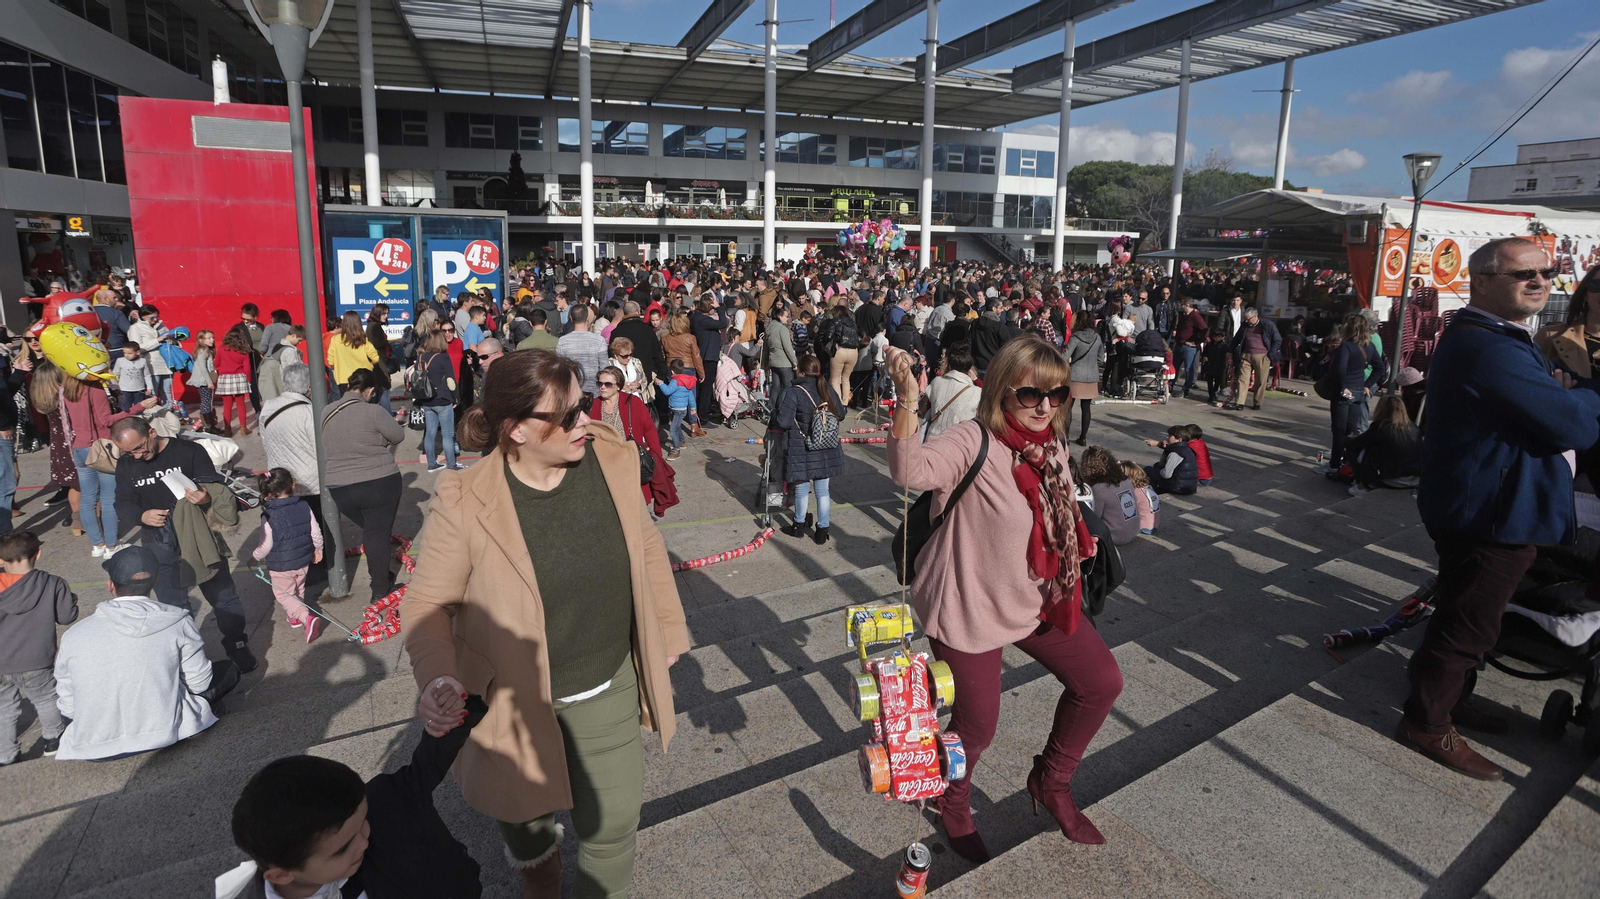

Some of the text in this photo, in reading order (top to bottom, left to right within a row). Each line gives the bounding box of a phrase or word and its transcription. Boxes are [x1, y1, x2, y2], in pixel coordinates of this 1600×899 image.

[376, 242, 392, 266] 4
[392, 260, 401, 268] 24
[467, 244, 481, 266] 4
[337, 250, 380, 304] P
[432, 250, 470, 296] P
